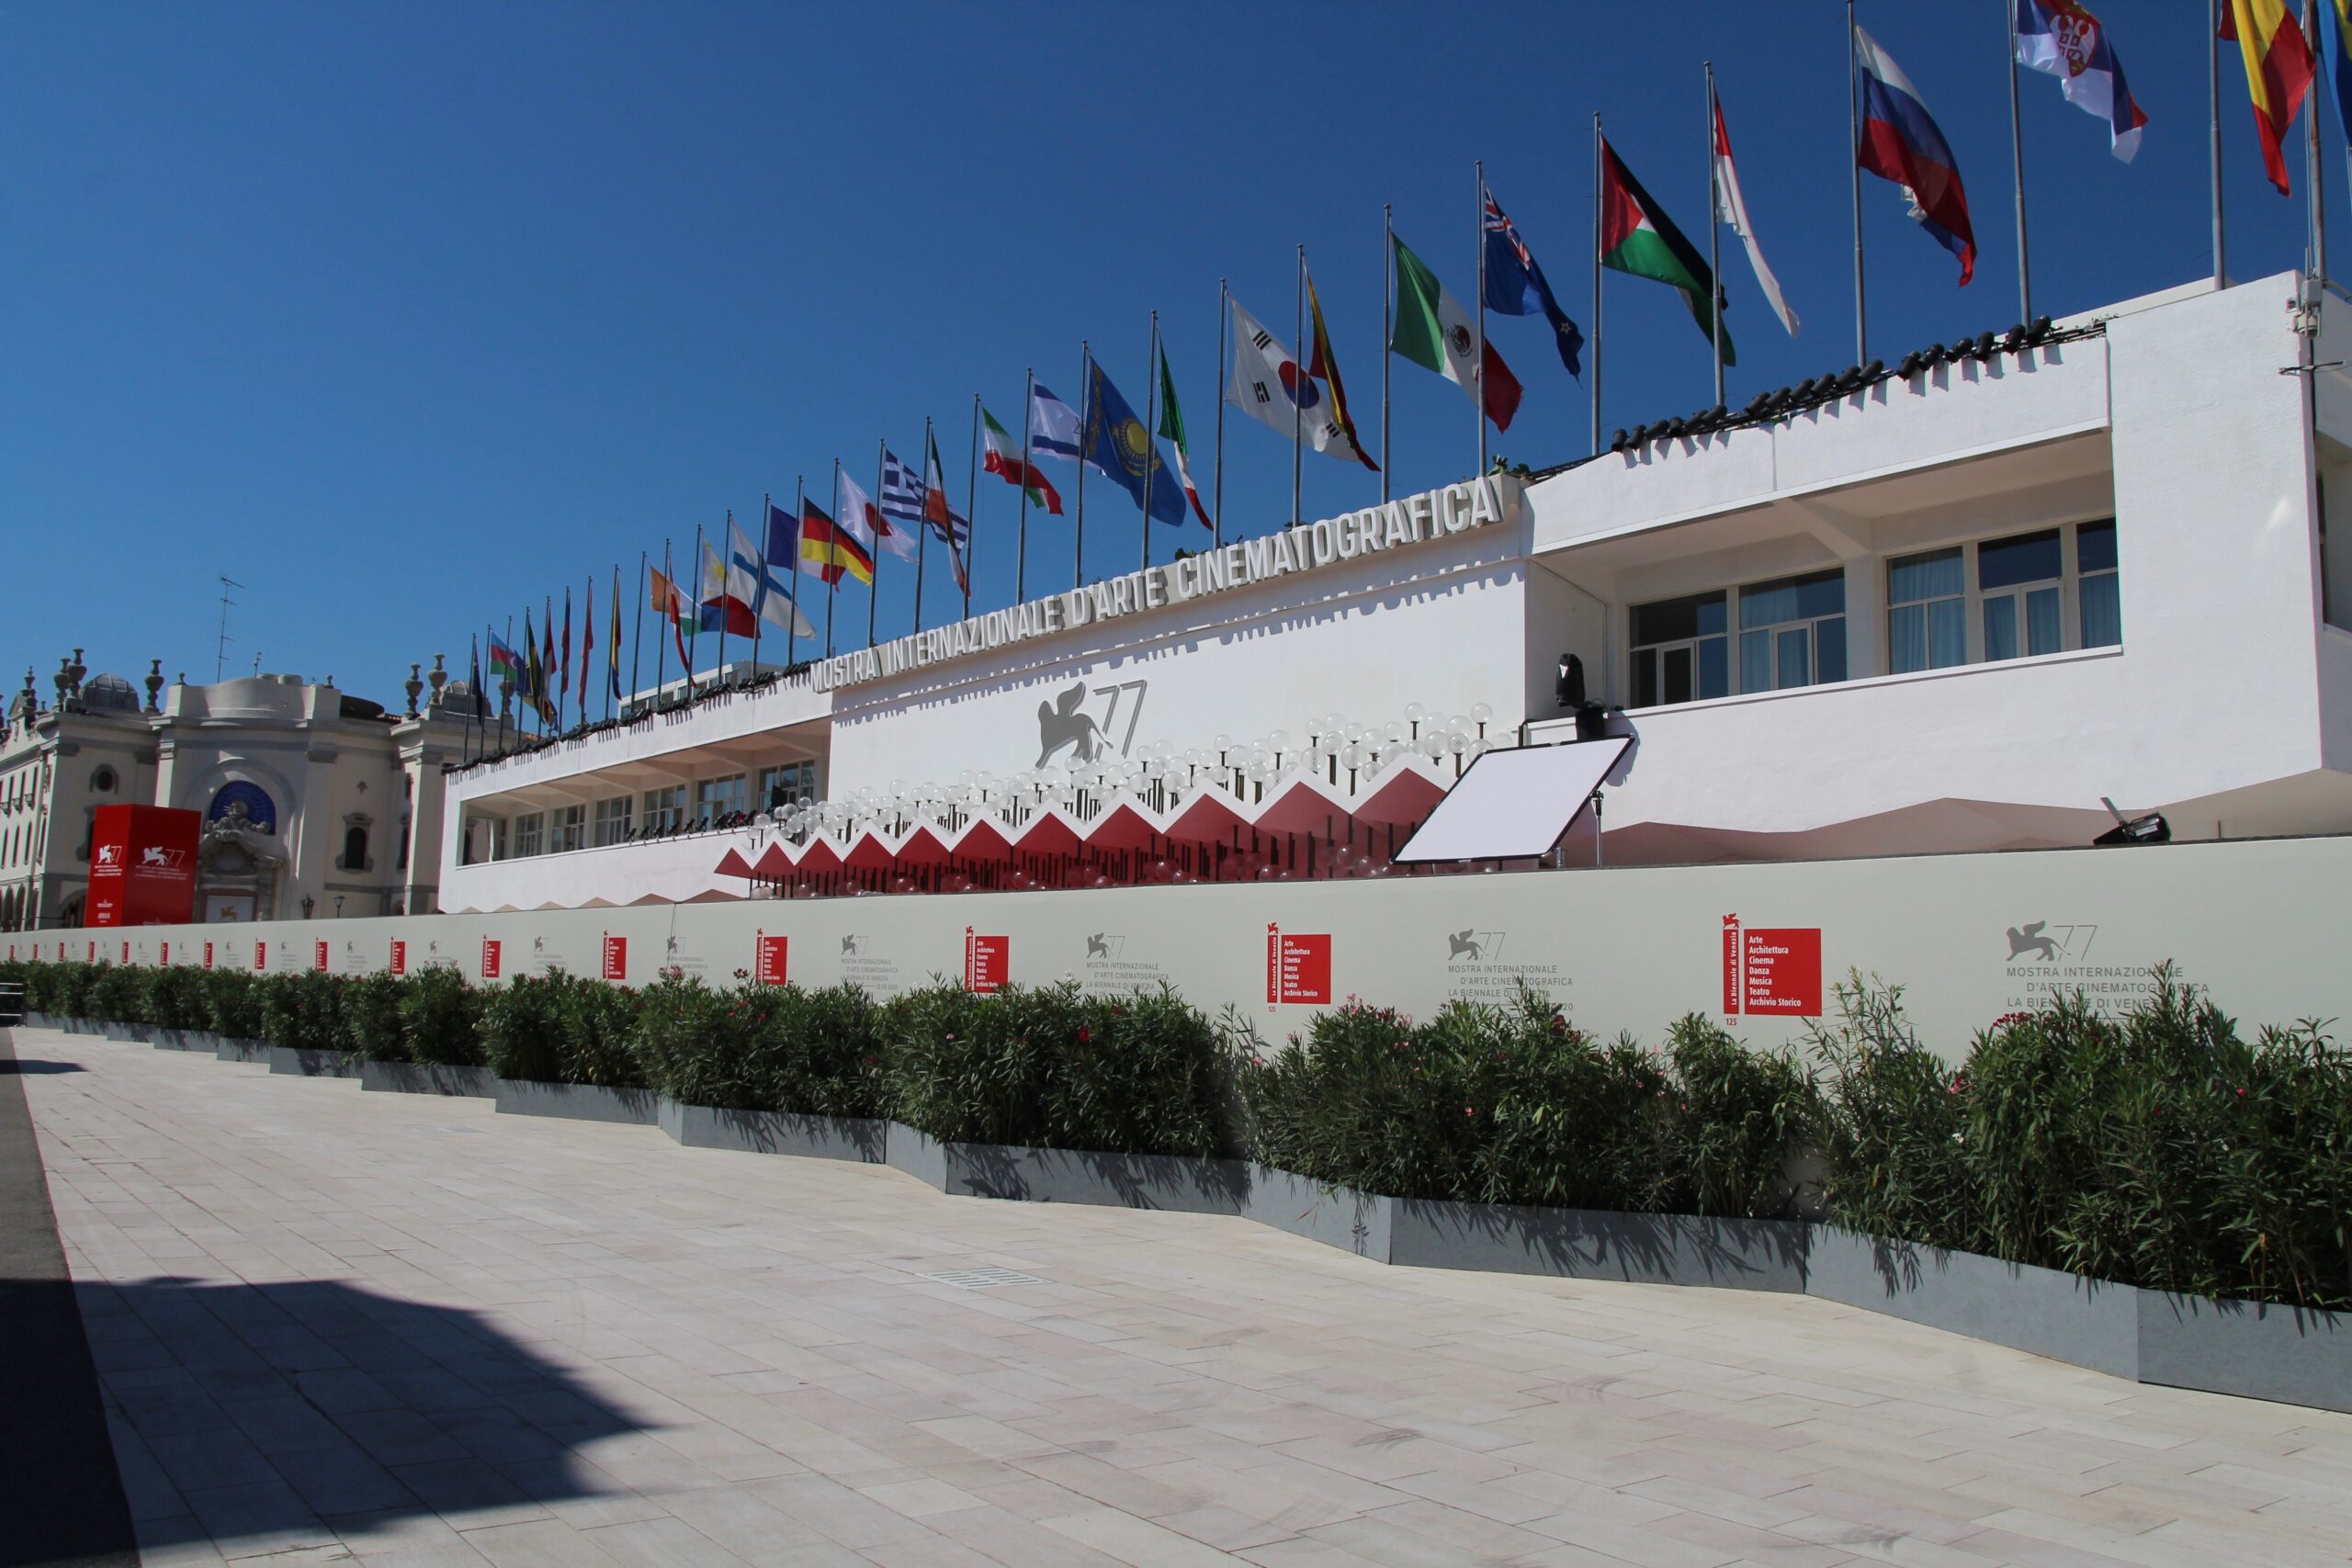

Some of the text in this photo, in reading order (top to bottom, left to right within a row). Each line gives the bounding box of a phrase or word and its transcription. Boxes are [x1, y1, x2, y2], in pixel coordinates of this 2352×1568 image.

[810, 476, 1500, 692] MOSTRA INTERNAZIONALE D'ARTE CINEMATOGRAFICA
[1092, 679, 1148, 762] 77
[1748, 936, 1763, 944] Arte
[2053, 924, 2098, 962] 77
[1478, 931, 1506, 961] 77
[1748, 946, 1789, 954] Architettura
[1748, 956, 1774, 964] Cinema
[1448, 965, 1557, 974] MOSTRA INTERNAZIONALE
[2007, 966, 2060, 977] MOSTRA
[1461, 977, 1489, 986] D'ARTE
[1749, 977, 1772, 986] Musica
[1749, 987, 1770, 996] Teatro
[2027, 982, 2073, 992] D'ARTE
[1448, 988, 1458, 997] LA
[1461, 989, 1500, 998] BIENNALE
[1504, 989, 1512, 998] DI
[1731, 998, 1737, 1006] La
[1749, 998, 1802, 1007] Archivio Storico
[2007, 997, 2022, 1008] LA
[2097, 998, 2109, 1008] DI
